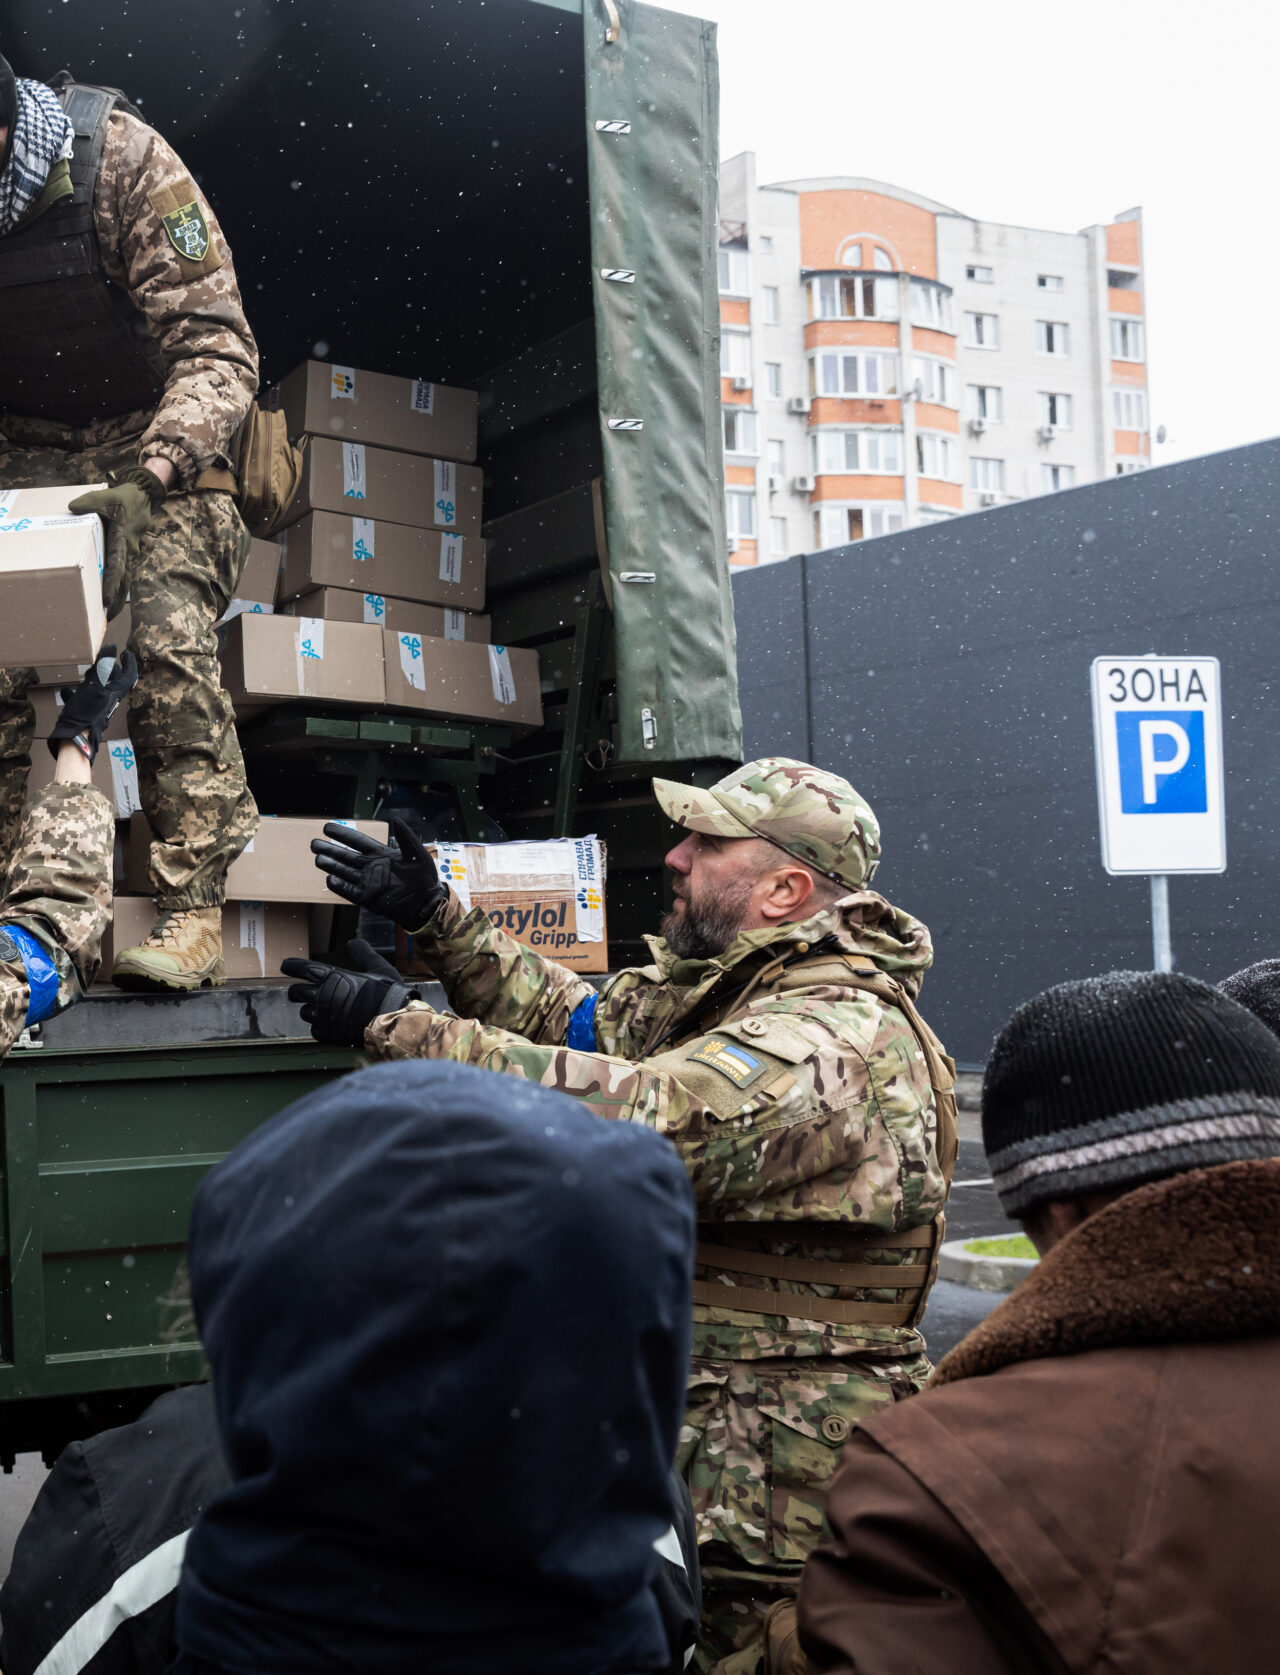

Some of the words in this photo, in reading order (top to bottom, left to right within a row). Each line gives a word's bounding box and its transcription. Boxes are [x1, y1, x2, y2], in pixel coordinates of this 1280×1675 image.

[1108, 667, 1208, 703] ЗОНА
[574, 841, 587, 880] СПРАВА
[583, 840, 595, 881] ГРОМАД
[530, 929, 587, 949] Gripp
[694, 1052, 743, 1081] UKRAINE
